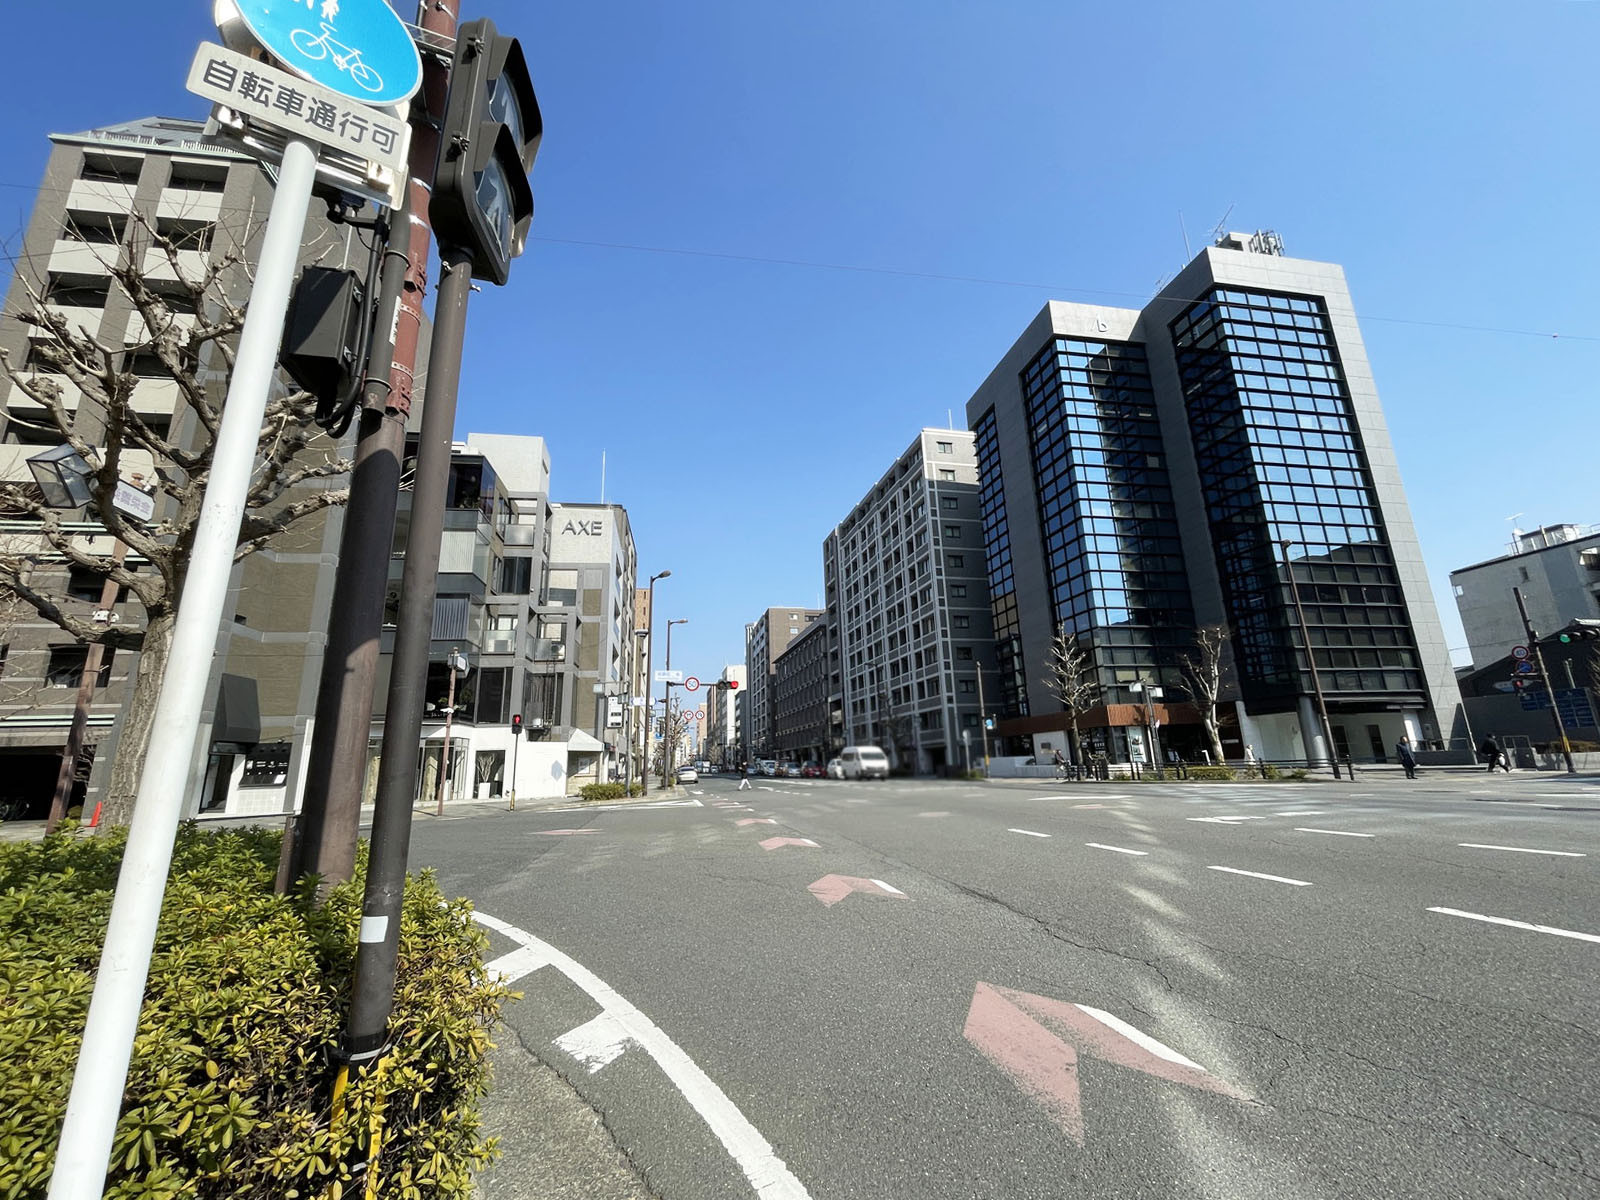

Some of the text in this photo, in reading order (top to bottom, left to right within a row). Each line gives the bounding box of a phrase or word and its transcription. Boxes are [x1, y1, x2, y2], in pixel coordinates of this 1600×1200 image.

[202, 58, 399, 155] 自転車通行可
[561, 519, 603, 537] AXE
[688, 680, 697, 688] 50
